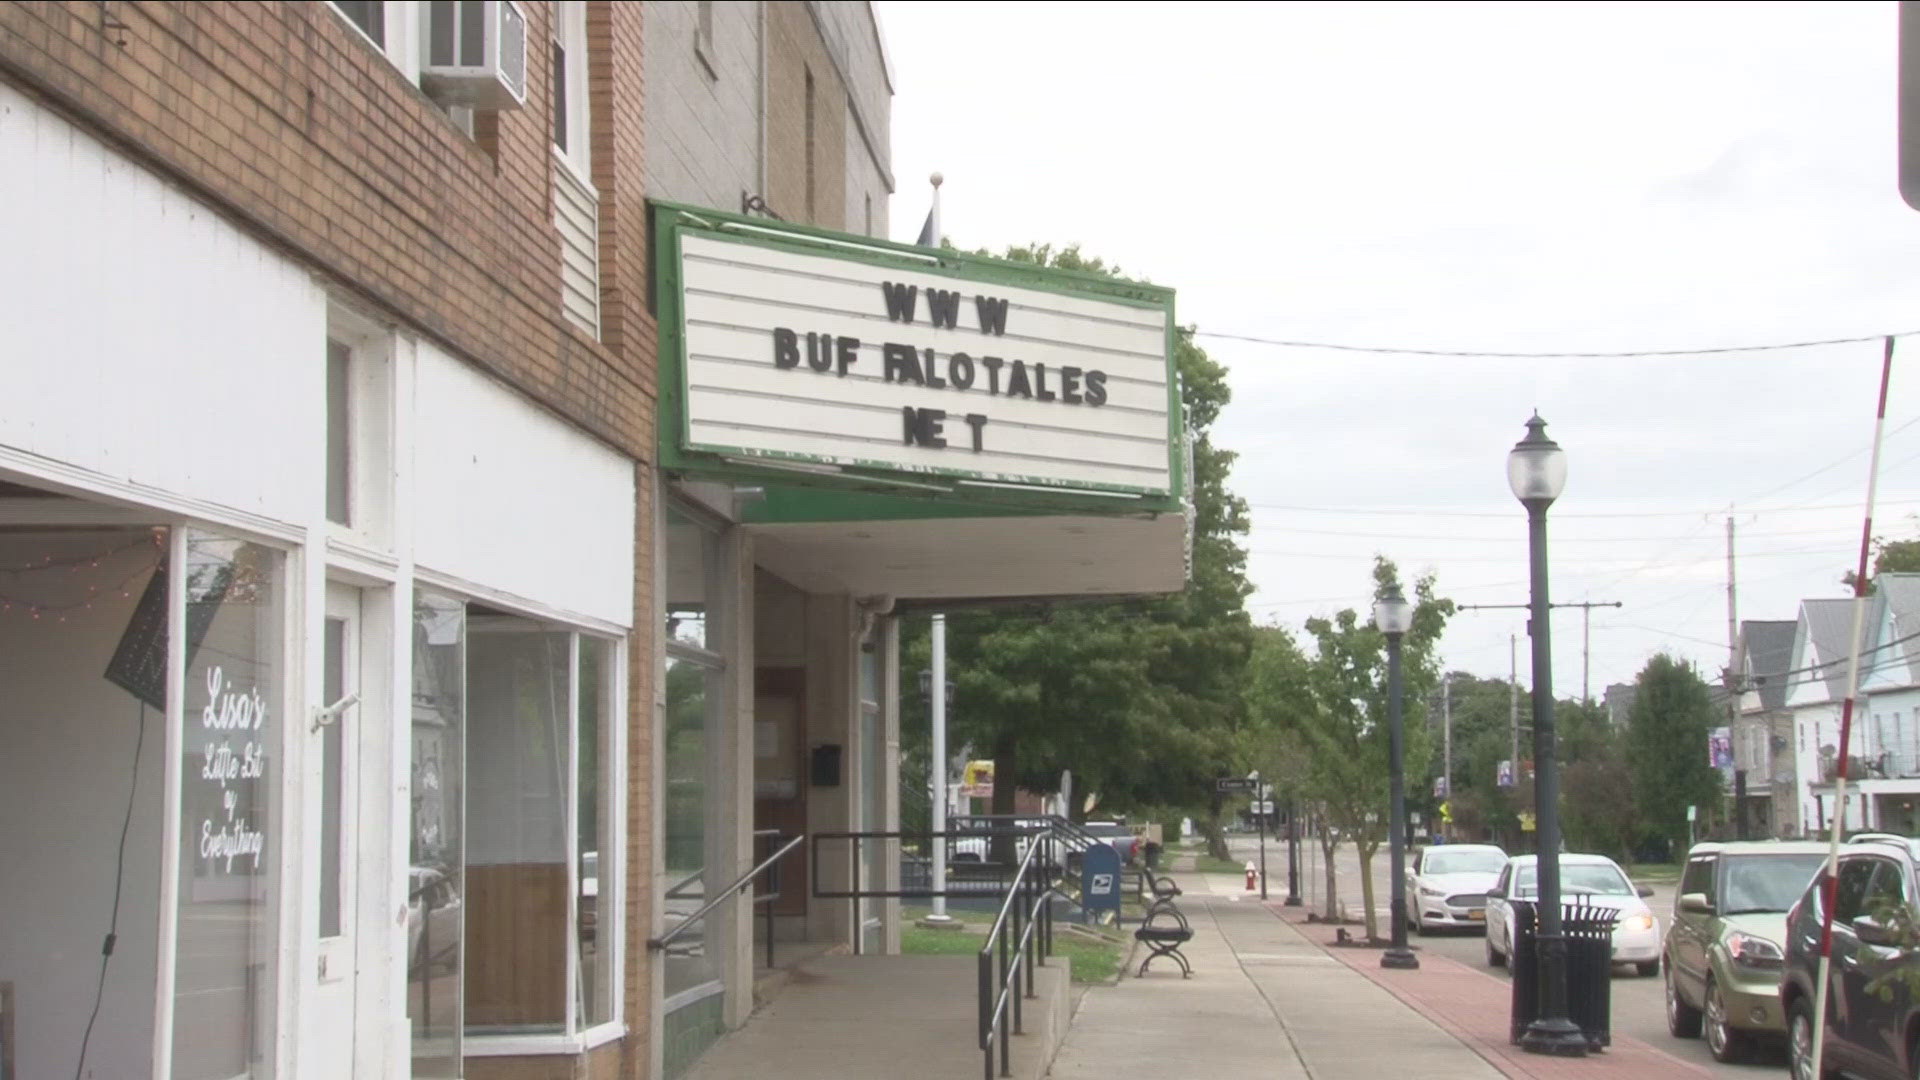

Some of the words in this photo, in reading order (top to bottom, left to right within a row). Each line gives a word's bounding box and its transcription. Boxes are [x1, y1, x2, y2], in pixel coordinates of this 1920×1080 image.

[203, 666, 266, 730] Lisa's
[202, 741, 239, 787] Little
[241, 742, 264, 778] Bit
[201, 819, 264, 874] Everything
